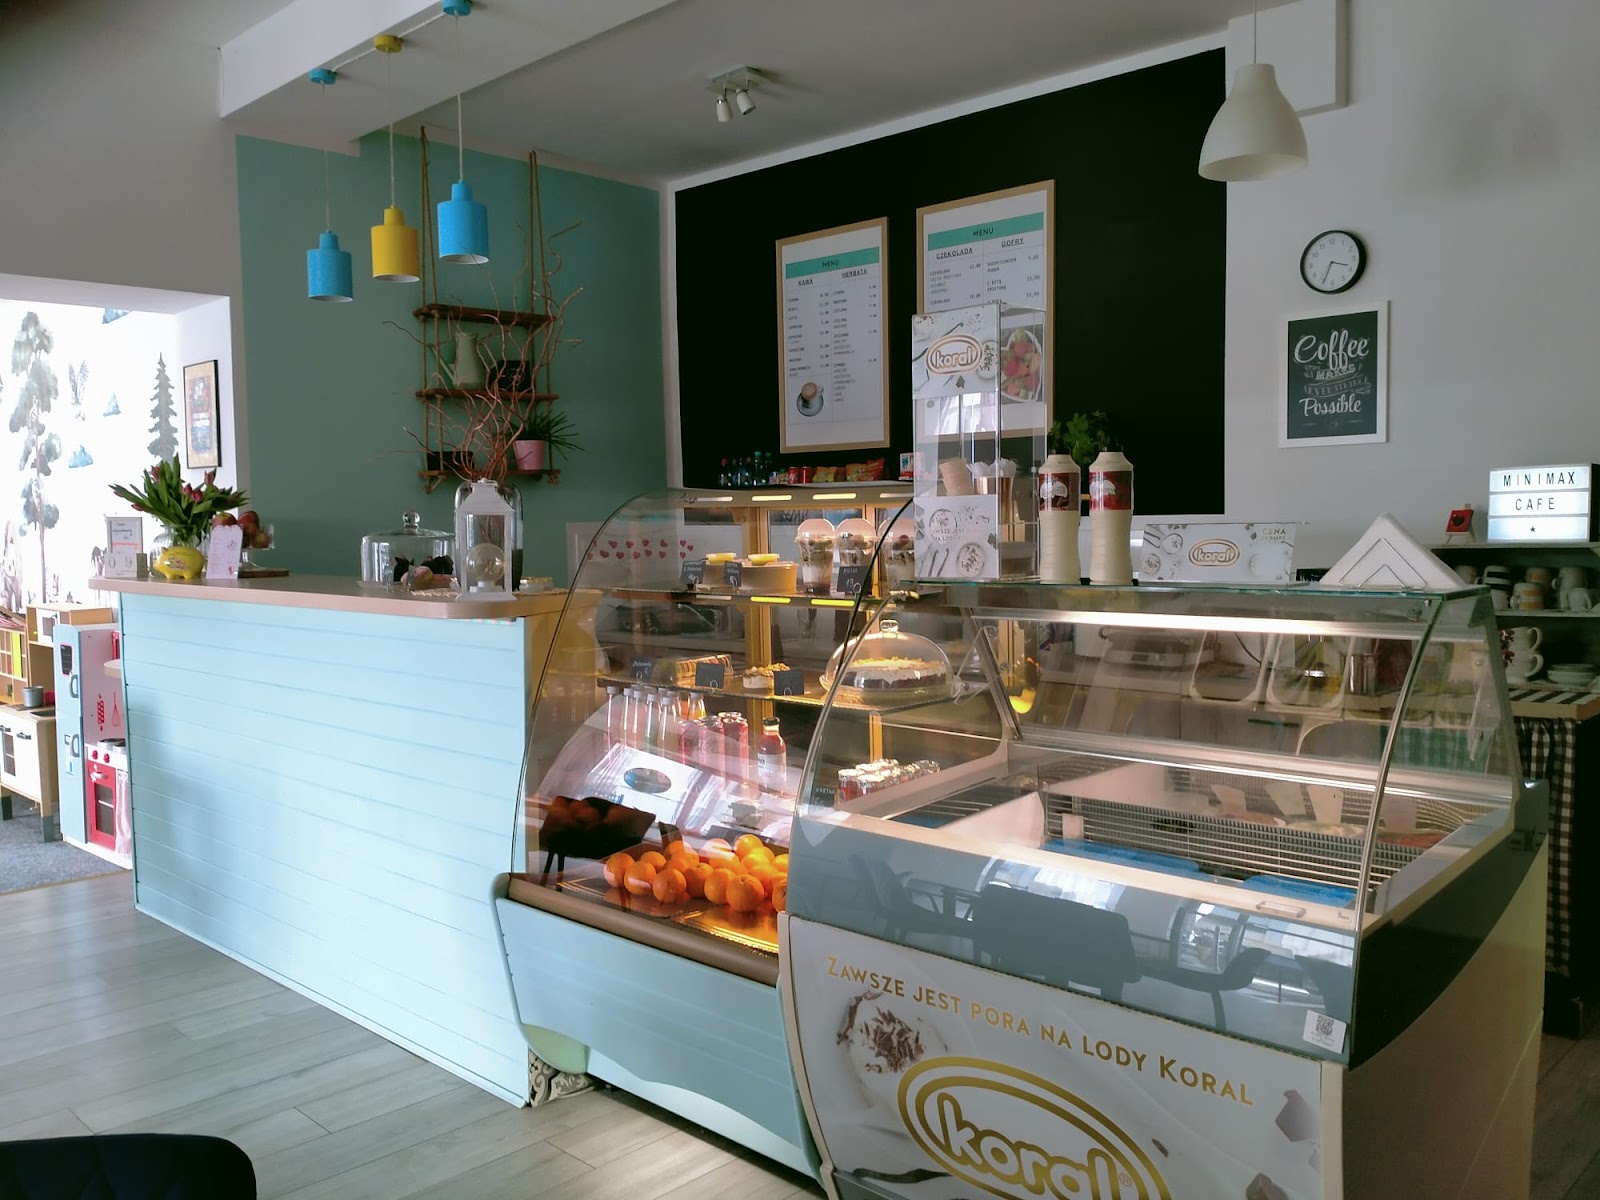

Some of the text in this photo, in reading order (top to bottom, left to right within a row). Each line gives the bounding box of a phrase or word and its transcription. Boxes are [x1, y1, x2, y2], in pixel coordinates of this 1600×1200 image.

[973, 227, 994, 237] MENU
[1001, 238, 1025, 249] GOFRY
[936, 247, 973, 260] CZEKOLADA
[935, 346, 975, 369] koral
[1294, 330, 1369, 371] Coffee
[1299, 393, 1362, 417] Possible
[1503, 471, 1575, 487] MINIMAX
[1515, 497, 1555, 511] CAFE
[1196, 547, 1234, 563] koral
[826, 956, 1255, 1106] ZAWSZE JEST PORA NA LODY KORAL
[935, 1092, 1121, 1200] koral
